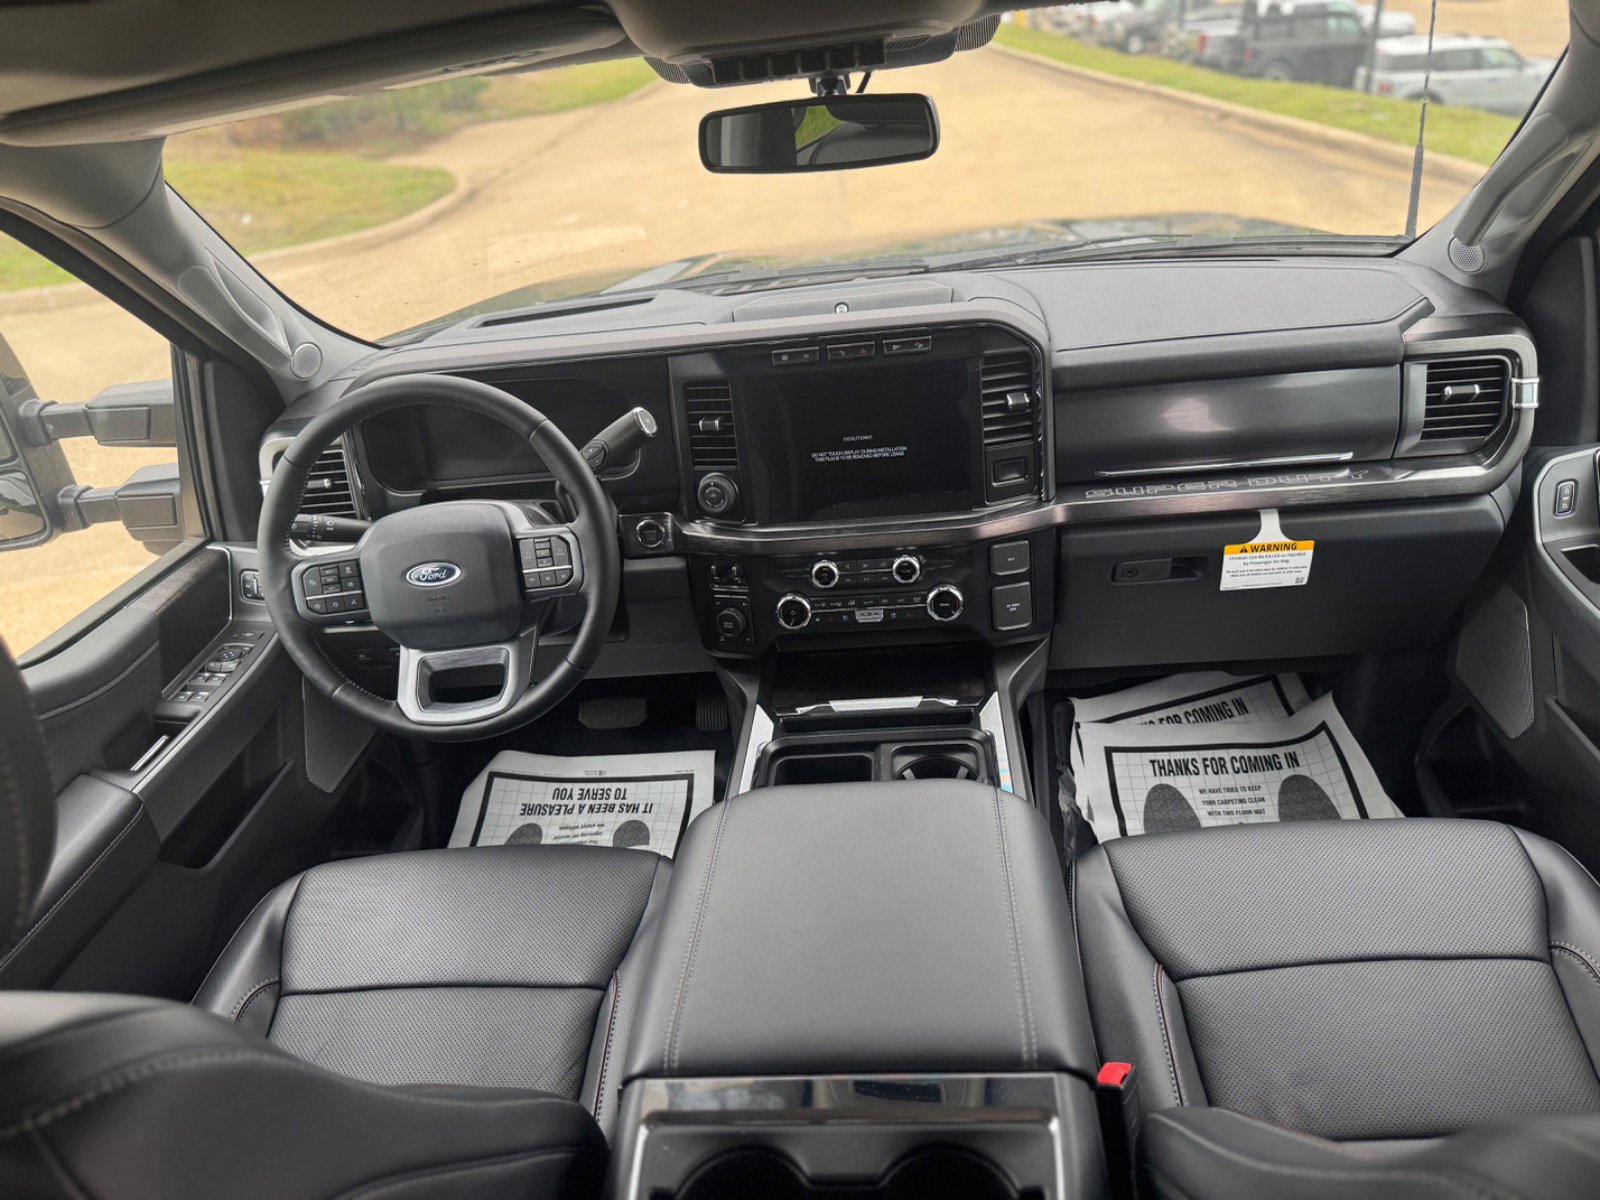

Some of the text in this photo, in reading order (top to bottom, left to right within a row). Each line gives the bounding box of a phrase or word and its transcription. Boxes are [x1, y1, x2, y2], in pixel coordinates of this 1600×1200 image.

[1085, 469, 1369, 498] SUPER DUTY
[1250, 543, 1297, 553] WARNING
[1184, 700, 1235, 724] COMING
[1231, 697, 1249, 716] IN
[1149, 751, 1300, 777] THANKS FOR COMING IN
[552, 787, 627, 800] TO SERVE YOU
[1216, 798, 1247, 806] CARPETING
[1247, 796, 1266, 804] CLEAN
[520, 803, 654, 816] IT HAS BEEN A PLEASURE
